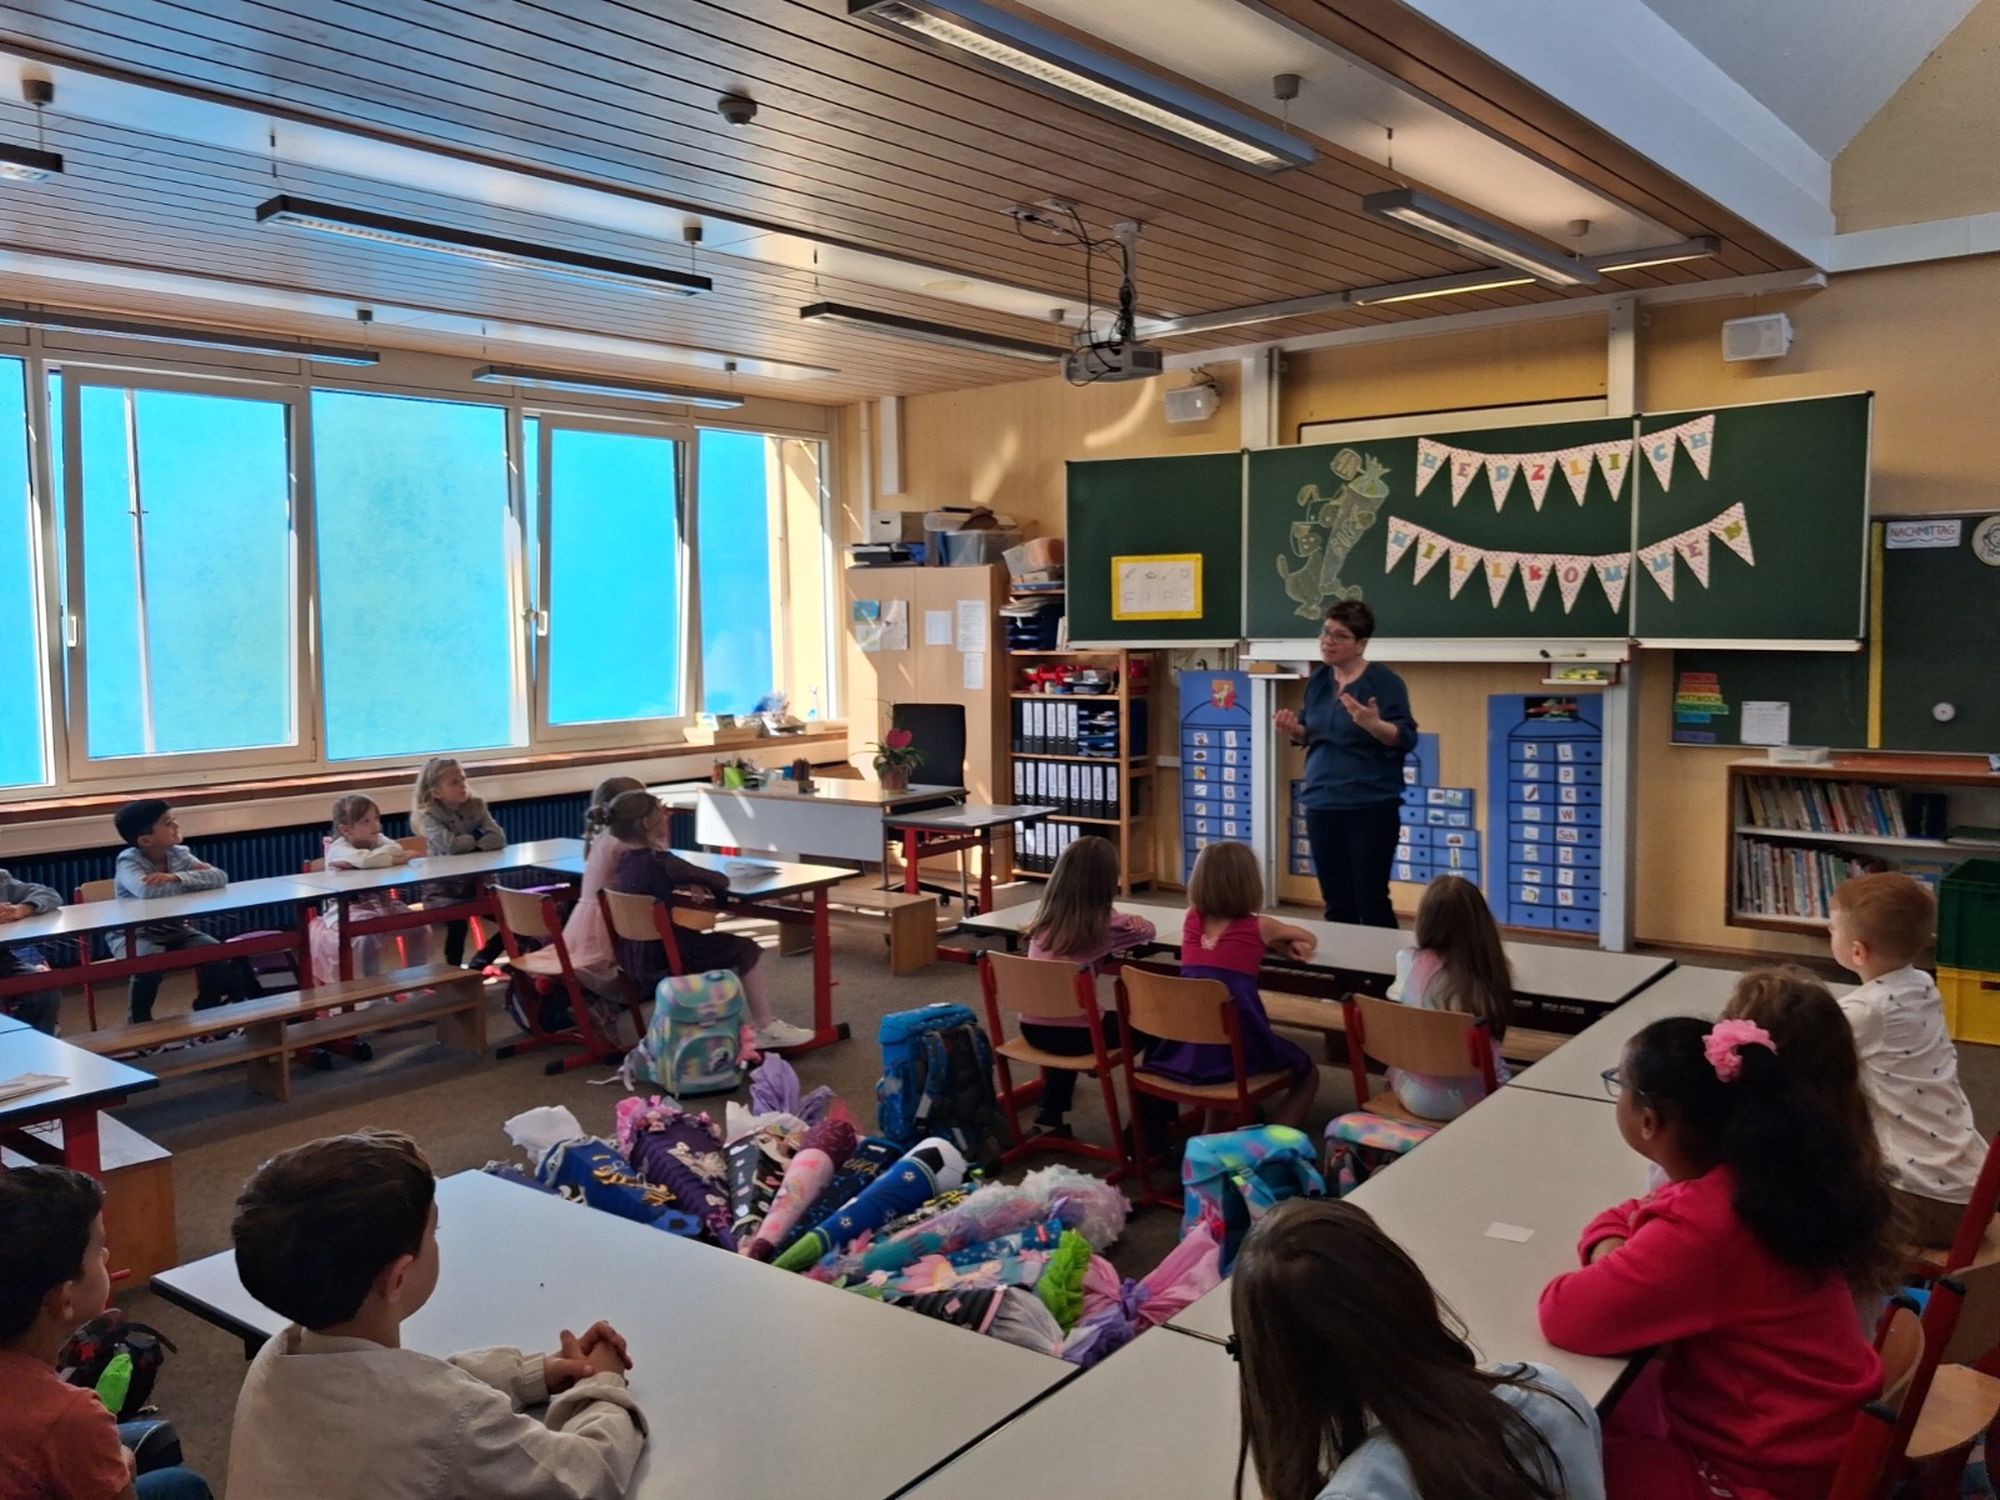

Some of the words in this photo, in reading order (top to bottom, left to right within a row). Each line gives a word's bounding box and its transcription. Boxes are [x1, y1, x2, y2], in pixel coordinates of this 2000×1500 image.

[1420, 431, 1709, 481] HERZLICH
[1890, 524, 1955, 537] NACHMITTAG
[1391, 520, 1743, 583] WILLKOMMEN
[1558, 829, 1576, 841] Sch
